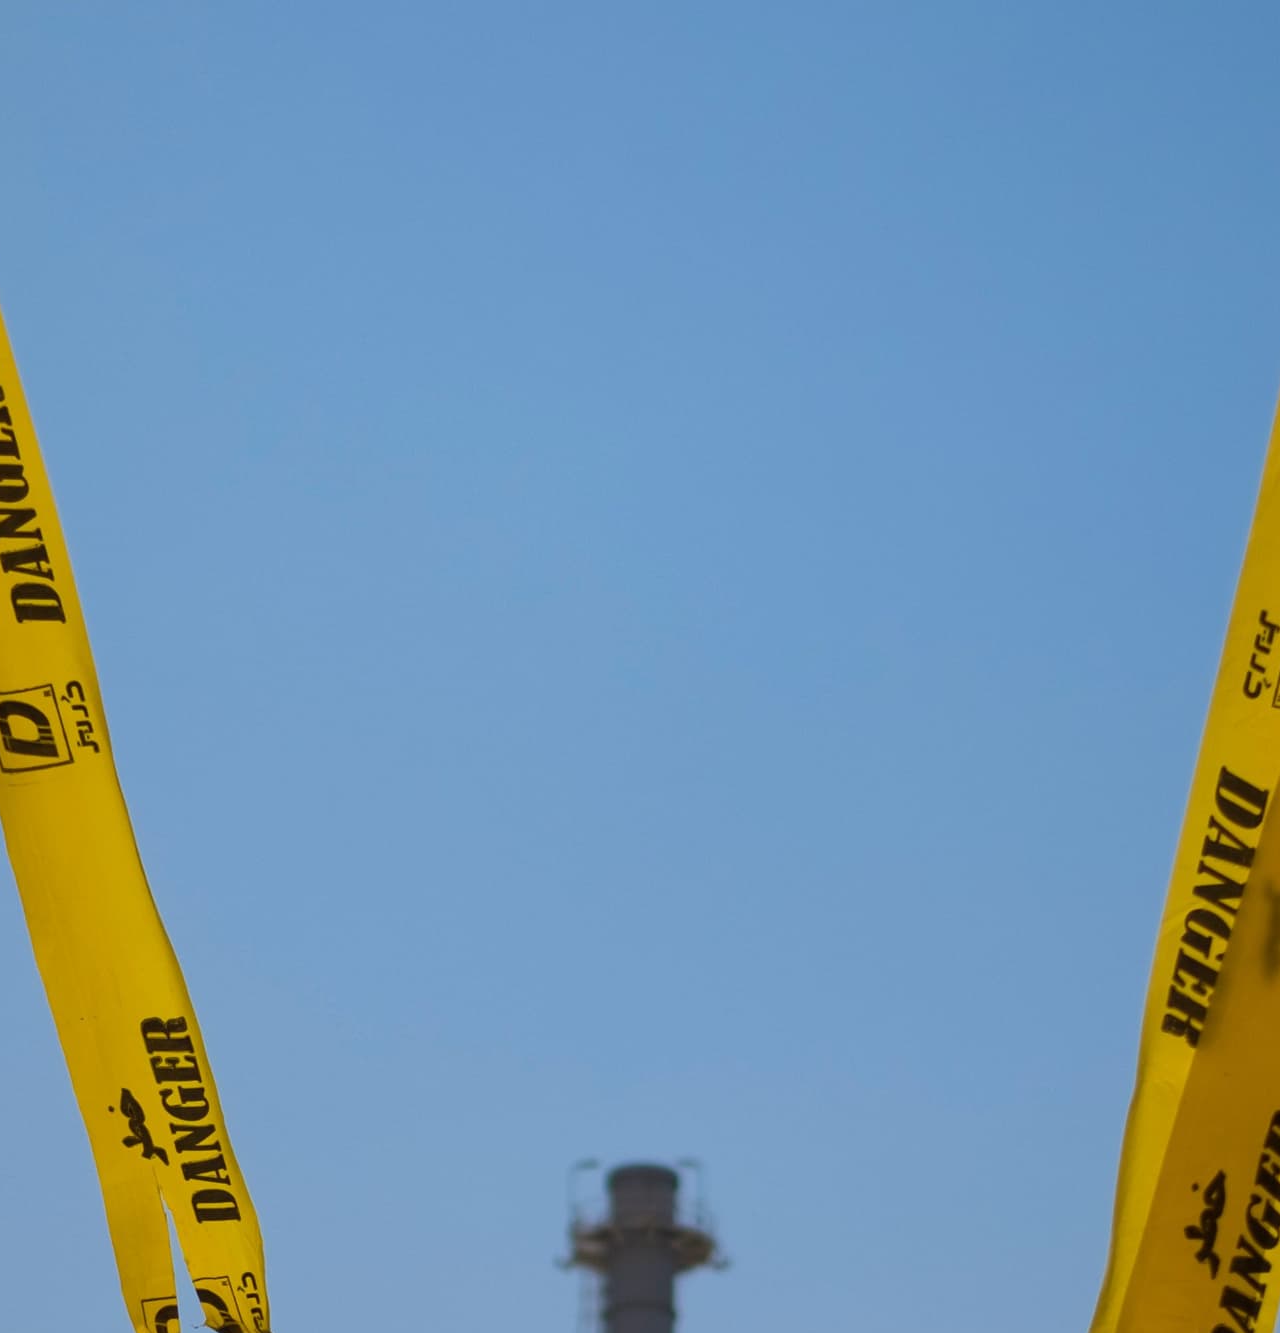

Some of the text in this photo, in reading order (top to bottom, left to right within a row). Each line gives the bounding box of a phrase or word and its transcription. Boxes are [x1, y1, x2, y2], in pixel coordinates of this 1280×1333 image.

[1161, 766, 1269, 1049] DANGER
[108, 1087, 170, 1166] خطر
[140, 1016, 242, 1224] DANGER
[1183, 1169, 1227, 1280] خطر
